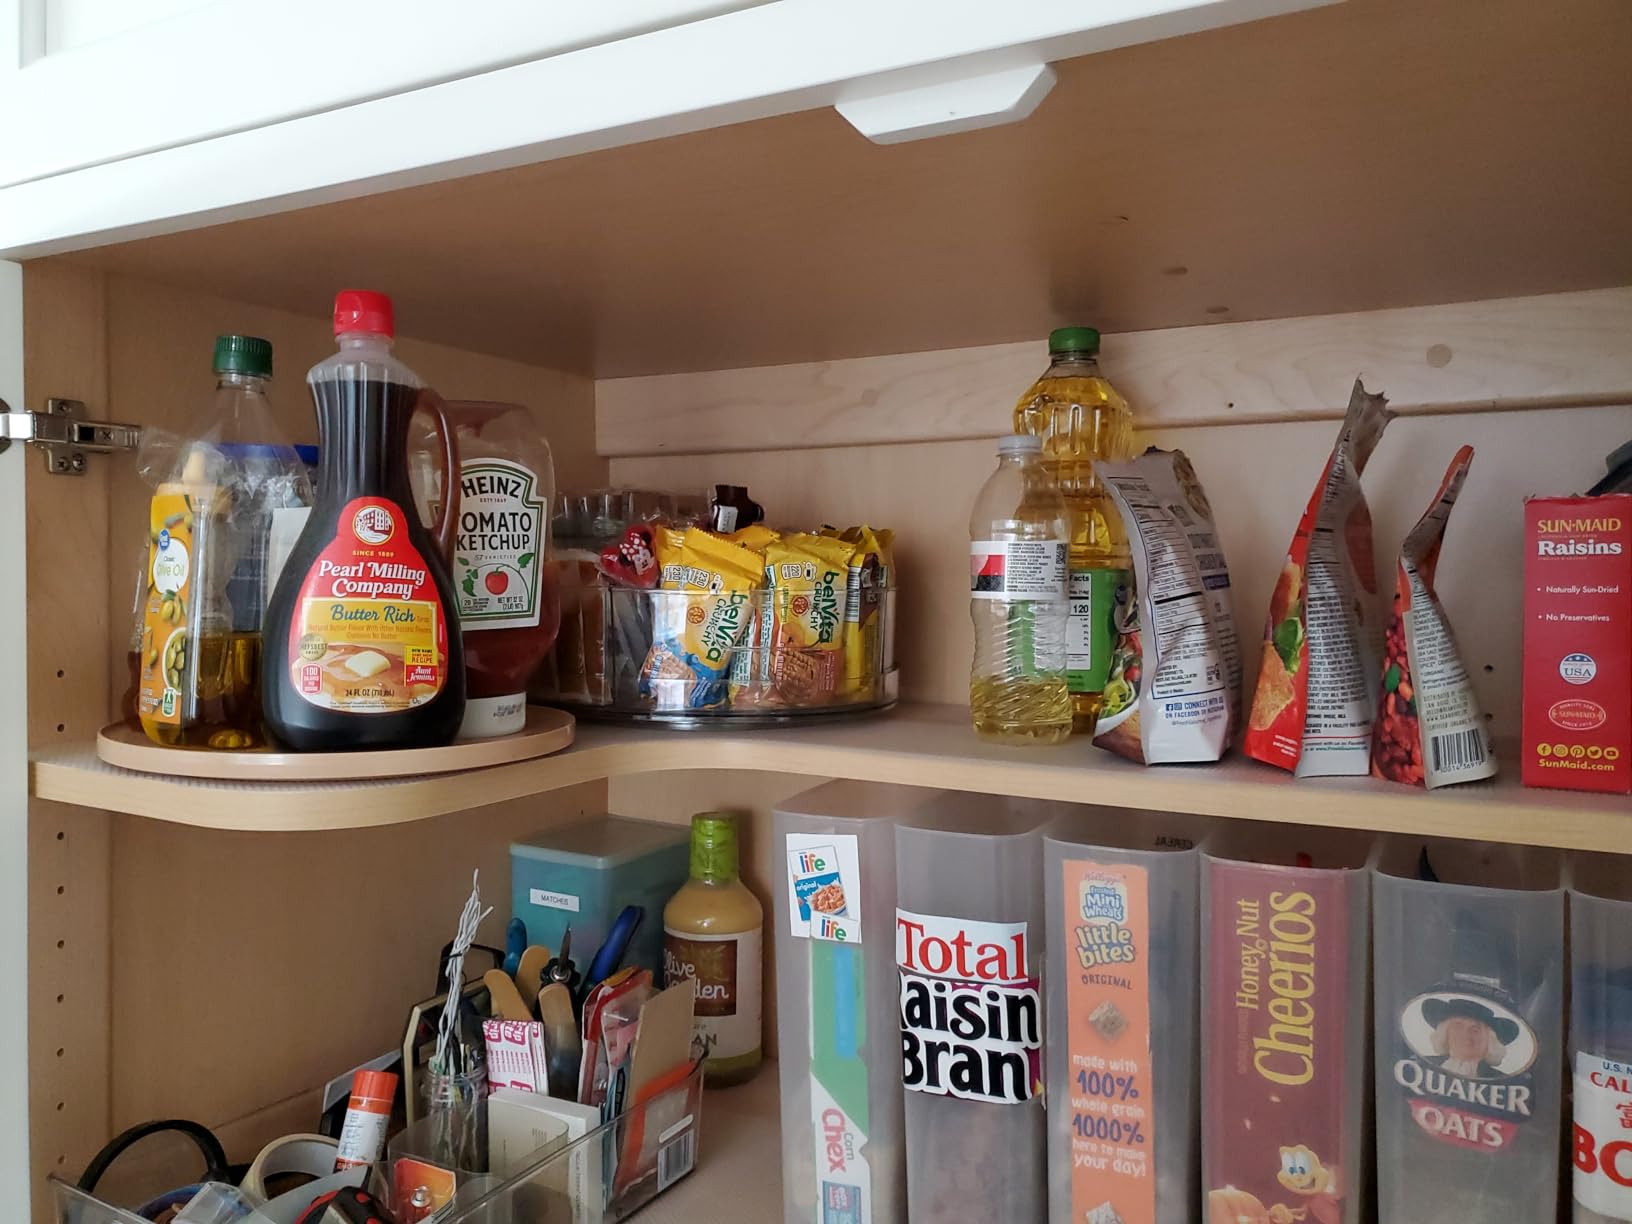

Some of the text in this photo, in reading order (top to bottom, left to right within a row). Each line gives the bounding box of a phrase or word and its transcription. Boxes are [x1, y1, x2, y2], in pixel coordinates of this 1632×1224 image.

[461, 475, 521, 498] HEINZ
[461, 512, 531, 532] OMATO
[457, 534, 530, 551] KETCHUP
[1538, 539, 1622, 556] Raisins
[157, 564, 171, 576] Olive
[319, 560, 426, 585] Pearl Milling
[332, 579, 415, 600] Company
[1546, 584, 1619, 594] Naturally Sun-Dried
[330, 604, 416, 624] Butter Rich
[810, 582, 822, 631] CRUNCHY
[819, 571, 840, 643] belVita
[1073, 604, 1089, 613] 120
[701, 598, 726, 646] CRUNCHY
[1560, 614, 1610, 622] Preservatives
[306, 667, 318, 676] 100
[416, 666, 431, 674] Aunt
[1564, 668, 1592, 676] USA
[362, 690, 370, 698] OZ
[1174, 710, 1200, 718] FACEBOOK
[1184, 700, 1208, 710] CONNECT
[1538, 758, 1615, 772] SunMaid.com
[800, 853, 826, 874] life
[796, 881, 817, 892] original
[541, 894, 568, 906] MATCHES
[1087, 894, 1122, 909] Mini
[1084, 906, 1124, 921] Wheats
[821, 919, 847, 940] life
[1075, 922, 1132, 948] little
[898, 918, 1028, 981] Total
[1076, 944, 1136, 970] bites
[1236, 898, 1268, 1010] Honey Nut
[664, 948, 696, 978] live
[1082, 974, 1134, 990] ORIGINAL
[1254, 892, 1316, 1086] Cheerios
[901, 980, 1040, 1044] aisin
[902, 1030, 1029, 1100] Bran
[1072, 1054, 1138, 1073] made with
[1602, 1061, 1622, 1072] U.S.
[1077, 1070, 1140, 1100] 100%
[1394, 1059, 1532, 1116] QUAKER
[1072, 1098, 1145, 1118] whole grain
[1072, 1112, 1145, 1146] 1000%
[1418, 1106, 1504, 1148] OATS
[822, 1108, 847, 1174] Chex
[1116, 1146, 1146, 1161] make
[1074, 1154, 1146, 1177] your day!
